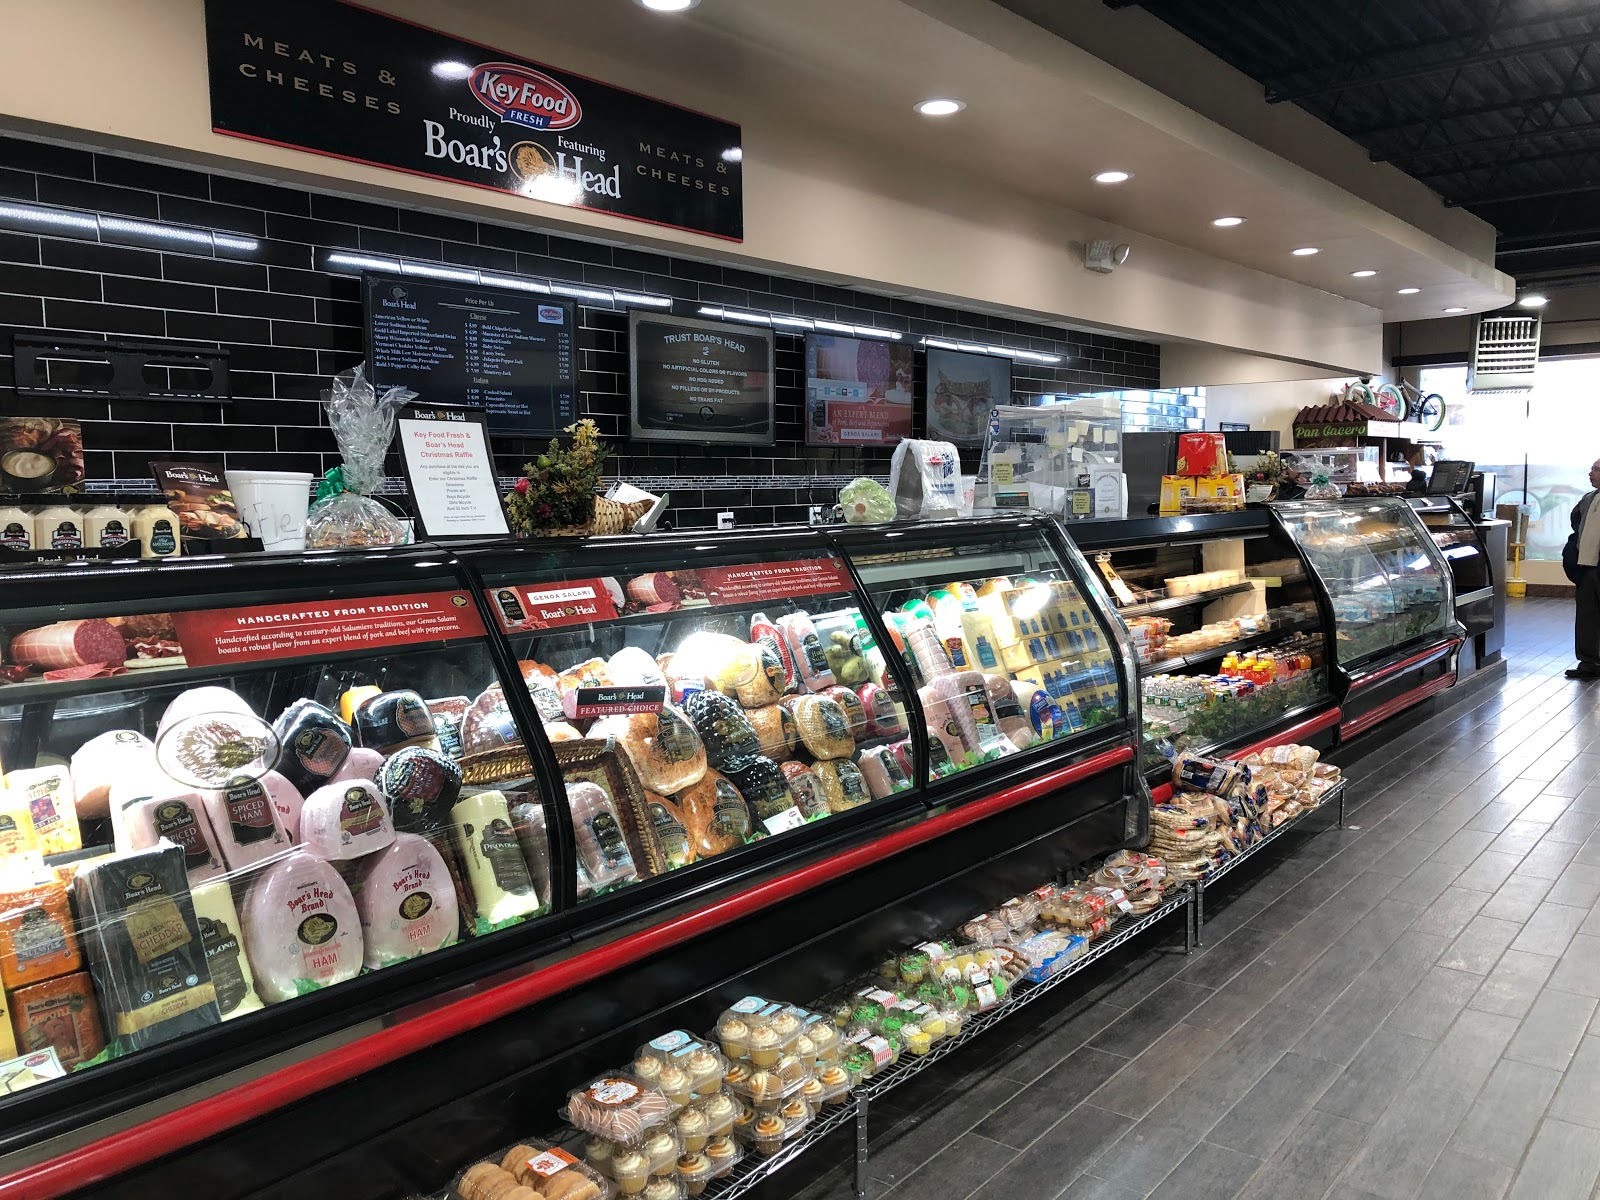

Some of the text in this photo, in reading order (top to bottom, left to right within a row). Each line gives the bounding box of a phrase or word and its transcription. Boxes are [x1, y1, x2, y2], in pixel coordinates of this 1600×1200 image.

[244, 33, 396, 85] MEATS &
[238, 63, 401, 115] CHEESES
[480, 71, 567, 115] Key Food
[448, 108, 495, 133] Proudly
[508, 109, 545, 127] FRESH
[557, 135, 606, 162] Featuring
[423, 119, 621, 199] Boar's Head
[639, 142, 727, 175] MEATS &
[636, 164, 730, 196] CHEESES
[383, 299, 416, 309] Boar's Head
[664, 334, 746, 353] TRUST BOAR'S HEAD
[414, 410, 465, 421] Boar's Head
[844, 411, 867, 419] EXPERT
[1296, 426, 1320, 438] Pan
[165, 470, 189, 480] Boar's
[199, 473, 219, 483] Head
[727, 569, 772, 579] HANDCRAFTED
[237, 602, 429, 625] HANDCRAFTED FROM TRADITION
[541, 604, 597, 619] Boar's Head
[215, 633, 259, 644] Handcrafted
[261, 631, 294, 640] according
[295, 629, 302, 637] to
[304, 626, 340, 636] century-old
[341, 624, 373, 632] Salumiere
[418, 617, 436, 625] Genoa
[218, 644, 240, 654] boasts
[249, 642, 270, 651] robust
[272, 641, 292, 650] flavor
[294, 638, 310, 648] from
[322, 635, 342, 645] expert
[363, 631, 369, 640] of
[370, 630, 384, 640] pork
[385, 629, 397, 637] and
[398, 628, 410, 636] beef
[598, 692, 644, 701] Boar's Head
[580, 704, 660, 715] FEATURED CHOICE
[232, 800, 265, 815] SPICED
[239, 809, 263, 822] HAM
[659, 828, 682, 836] ENGOLD
[392, 870, 431, 891] Boar's Head
[403, 879, 423, 892] Brand
[125, 883, 161, 900] Boar's Head
[287, 887, 334, 912] Boar's Head
[301, 898, 325, 913] Brand
[139, 923, 183, 950] CHEDDAR
[409, 924, 431, 941] HAM
[205, 939, 236, 958] OLONE
[312, 953, 338, 969] HAM
[161, 1001, 189, 1015] CHEDDAR
